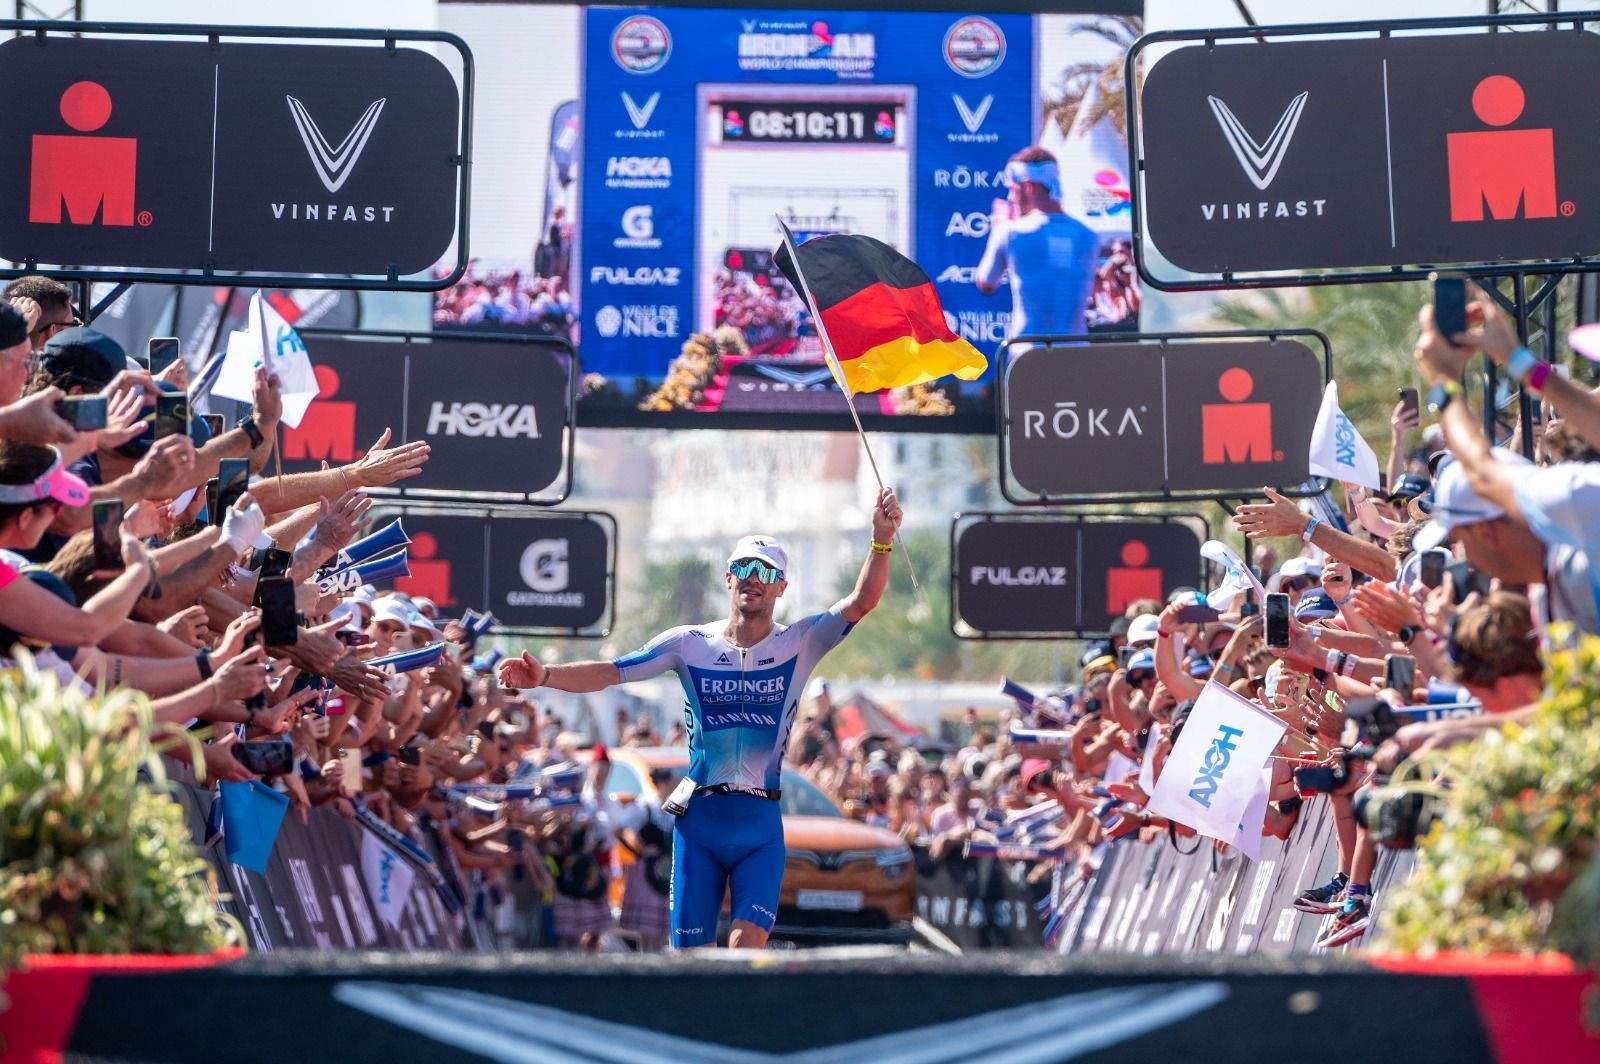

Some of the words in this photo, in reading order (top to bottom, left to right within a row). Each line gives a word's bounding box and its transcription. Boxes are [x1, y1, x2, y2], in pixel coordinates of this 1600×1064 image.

[749, 111, 865, 139] 08:10:11
[271, 203, 395, 223] VINFAST
[1201, 199, 1327, 220] VINFAST
[945, 212, 992, 239] AG
[591, 266, 681, 286] FULGAZ
[623, 318, 680, 337] NICE
[960, 322, 1010, 343] NIC
[427, 402, 540, 439] HOKA
[970, 566, 1067, 587] FULGAZ
[701, 675, 785, 694] ERDINGER
[706, 711, 776, 727] CANYON
